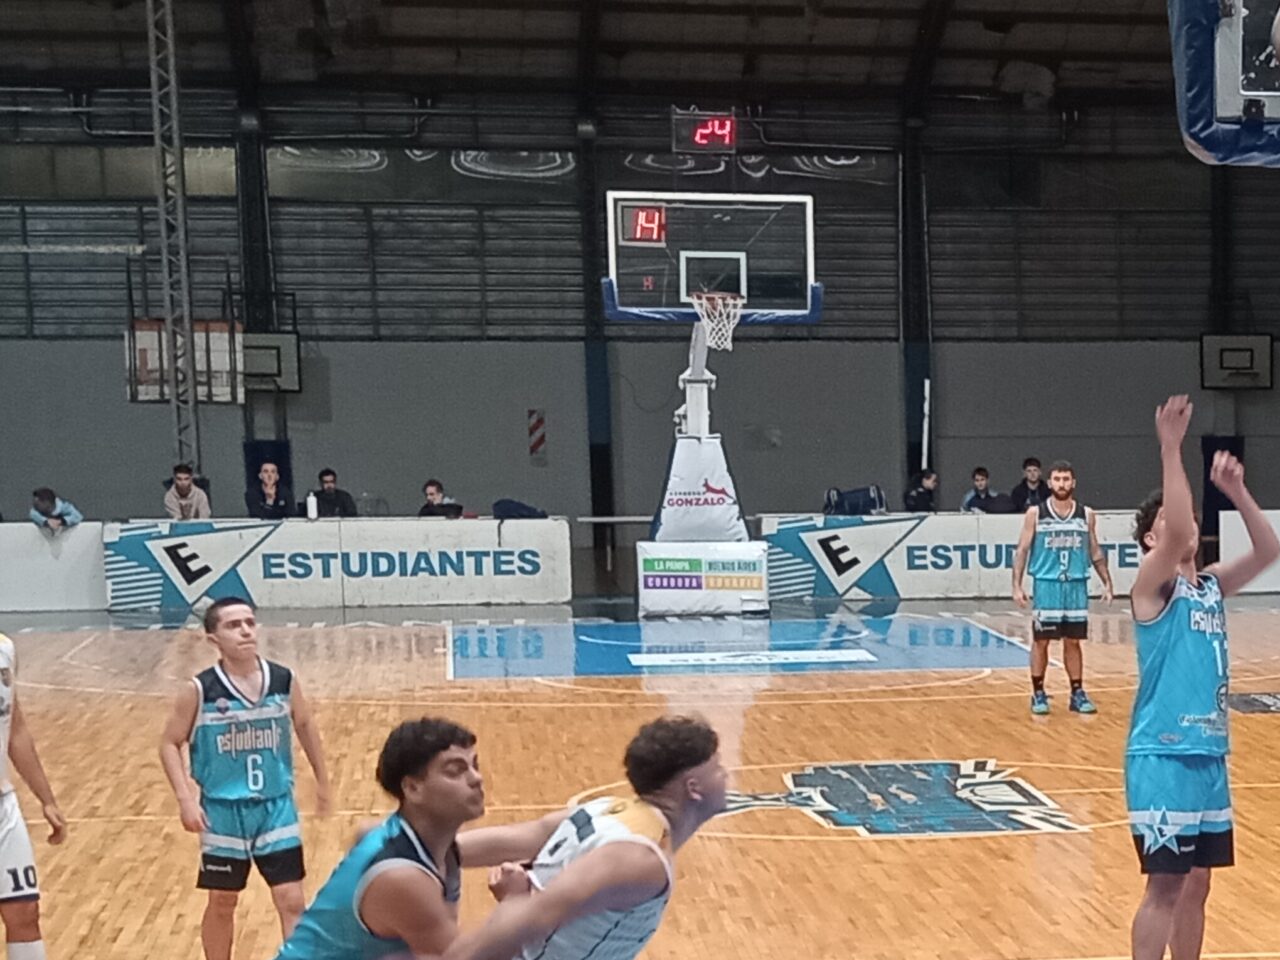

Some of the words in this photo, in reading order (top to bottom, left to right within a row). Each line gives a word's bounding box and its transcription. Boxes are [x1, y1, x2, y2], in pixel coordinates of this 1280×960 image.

[695, 120, 731, 144] 24
[636, 211, 660, 240] 14
[667, 497, 726, 507] GONZALO
[162, 542, 212, 586] E
[262, 549, 541, 579] ESTUDIANTES
[906, 543, 1139, 571] ESTUTE
[1060, 550, 1069, 570] 9
[1213, 640, 1228, 677] 1
[247, 754, 264, 791] 6
[8, 864, 37, 893] 10
